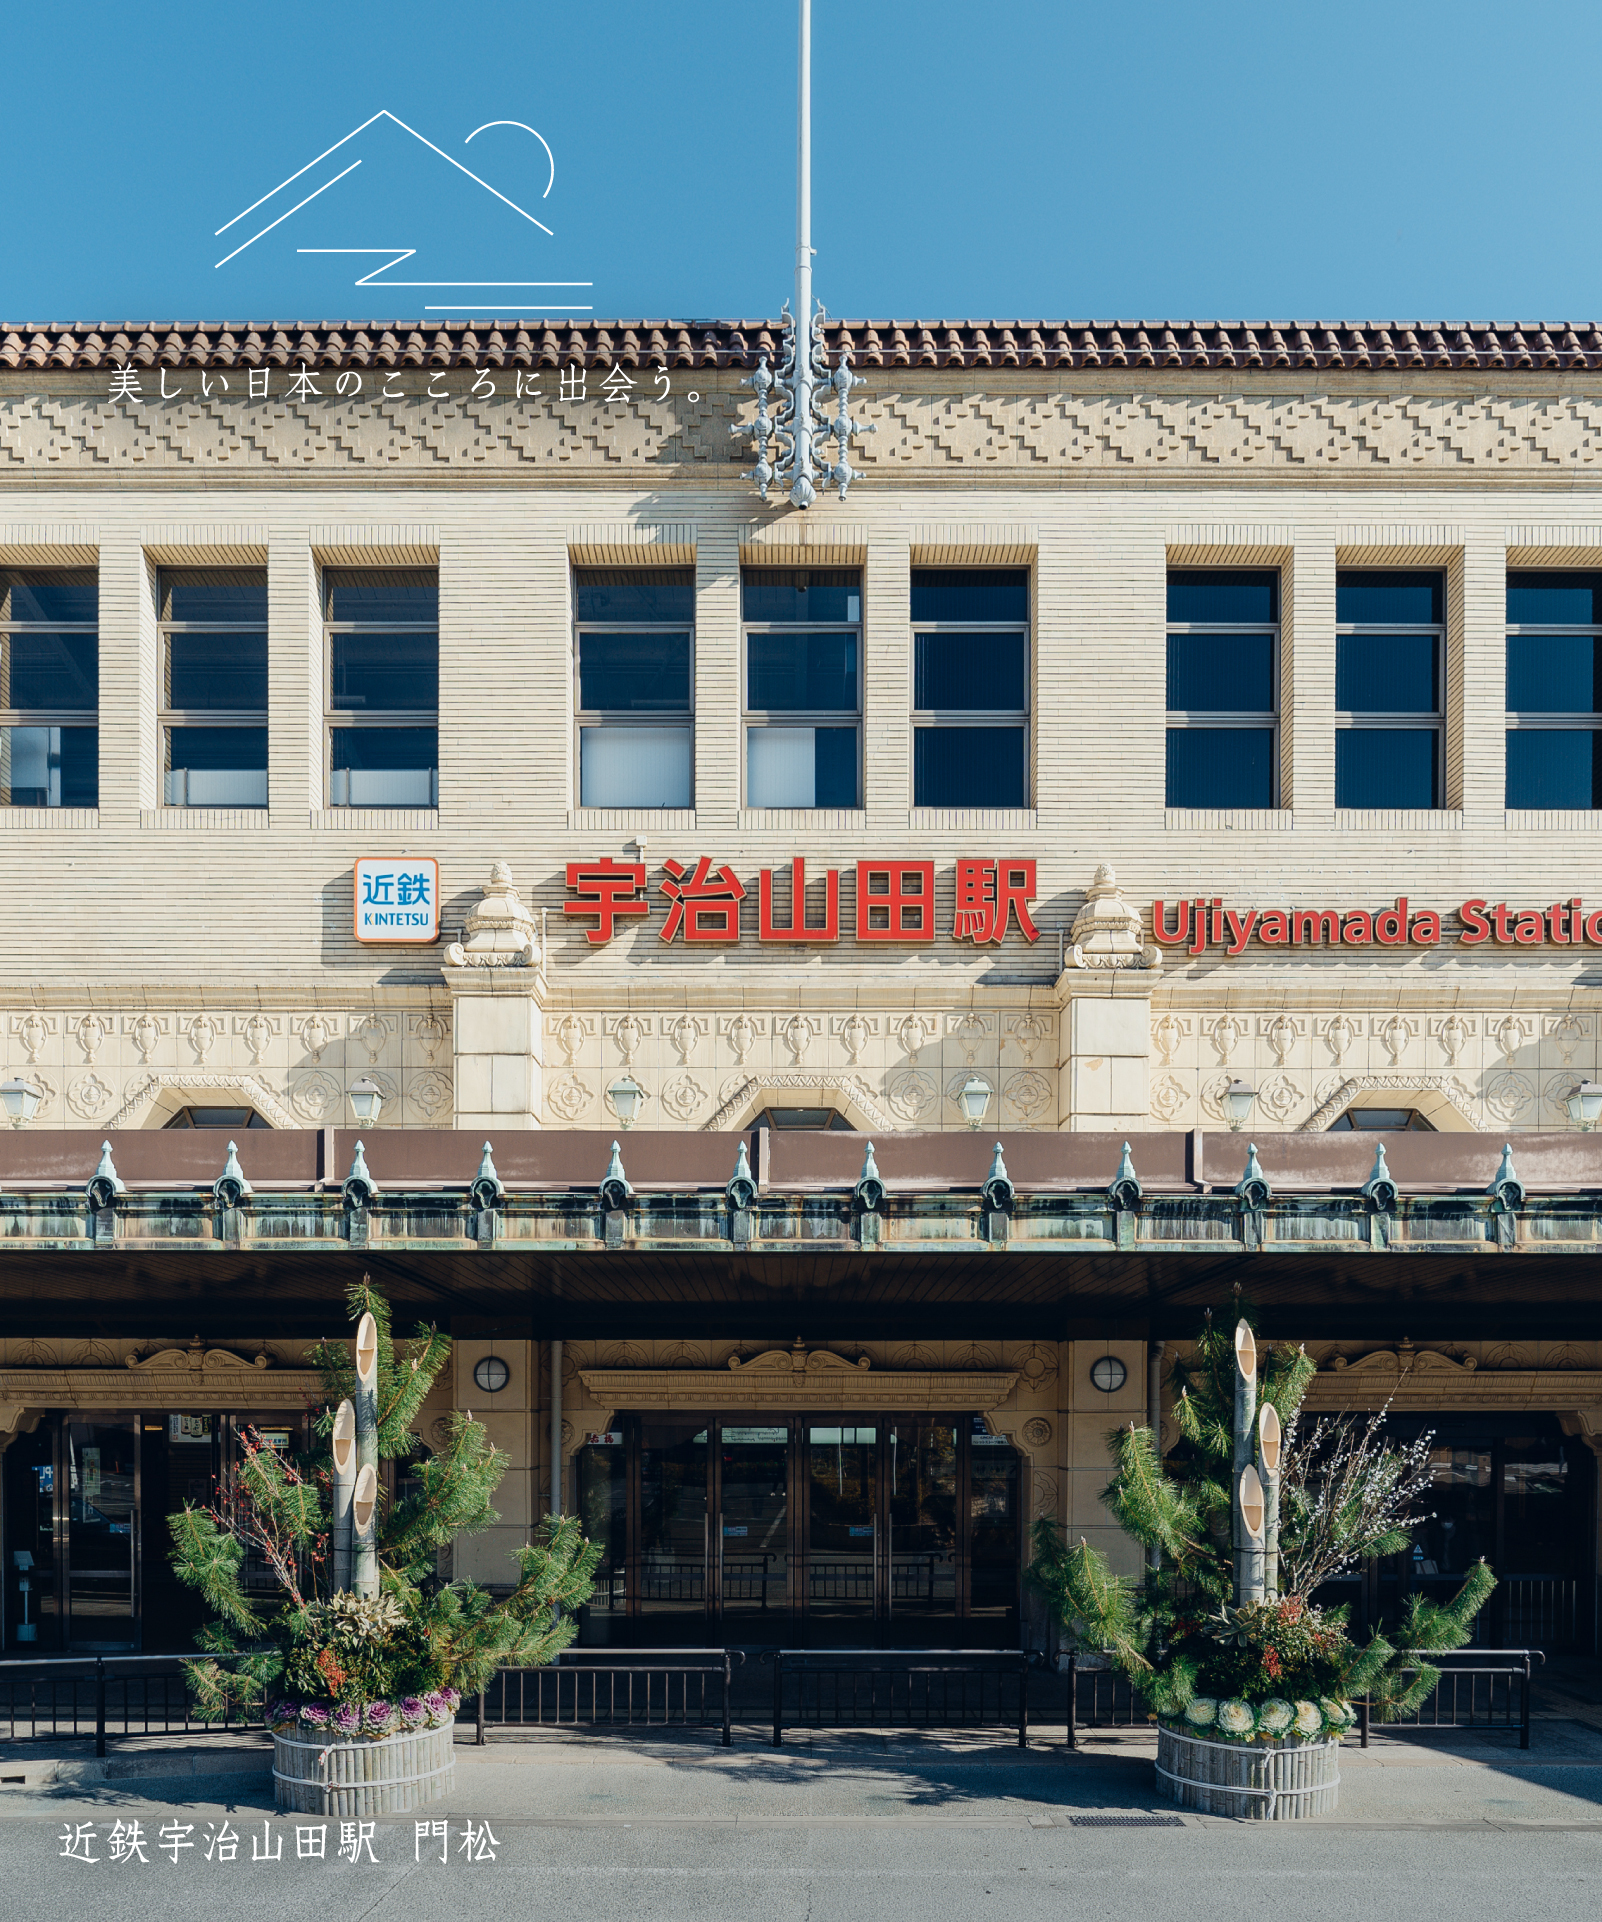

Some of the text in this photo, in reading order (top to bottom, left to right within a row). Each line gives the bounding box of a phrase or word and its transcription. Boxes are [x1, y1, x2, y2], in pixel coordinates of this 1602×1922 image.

[362, 872, 431, 906] 近鉄
[563, 856, 1042, 943] 宇治山田駅
[364, 912, 429, 926] KINTETSU
[1152, 897, 1442, 956] Ujiyamada
